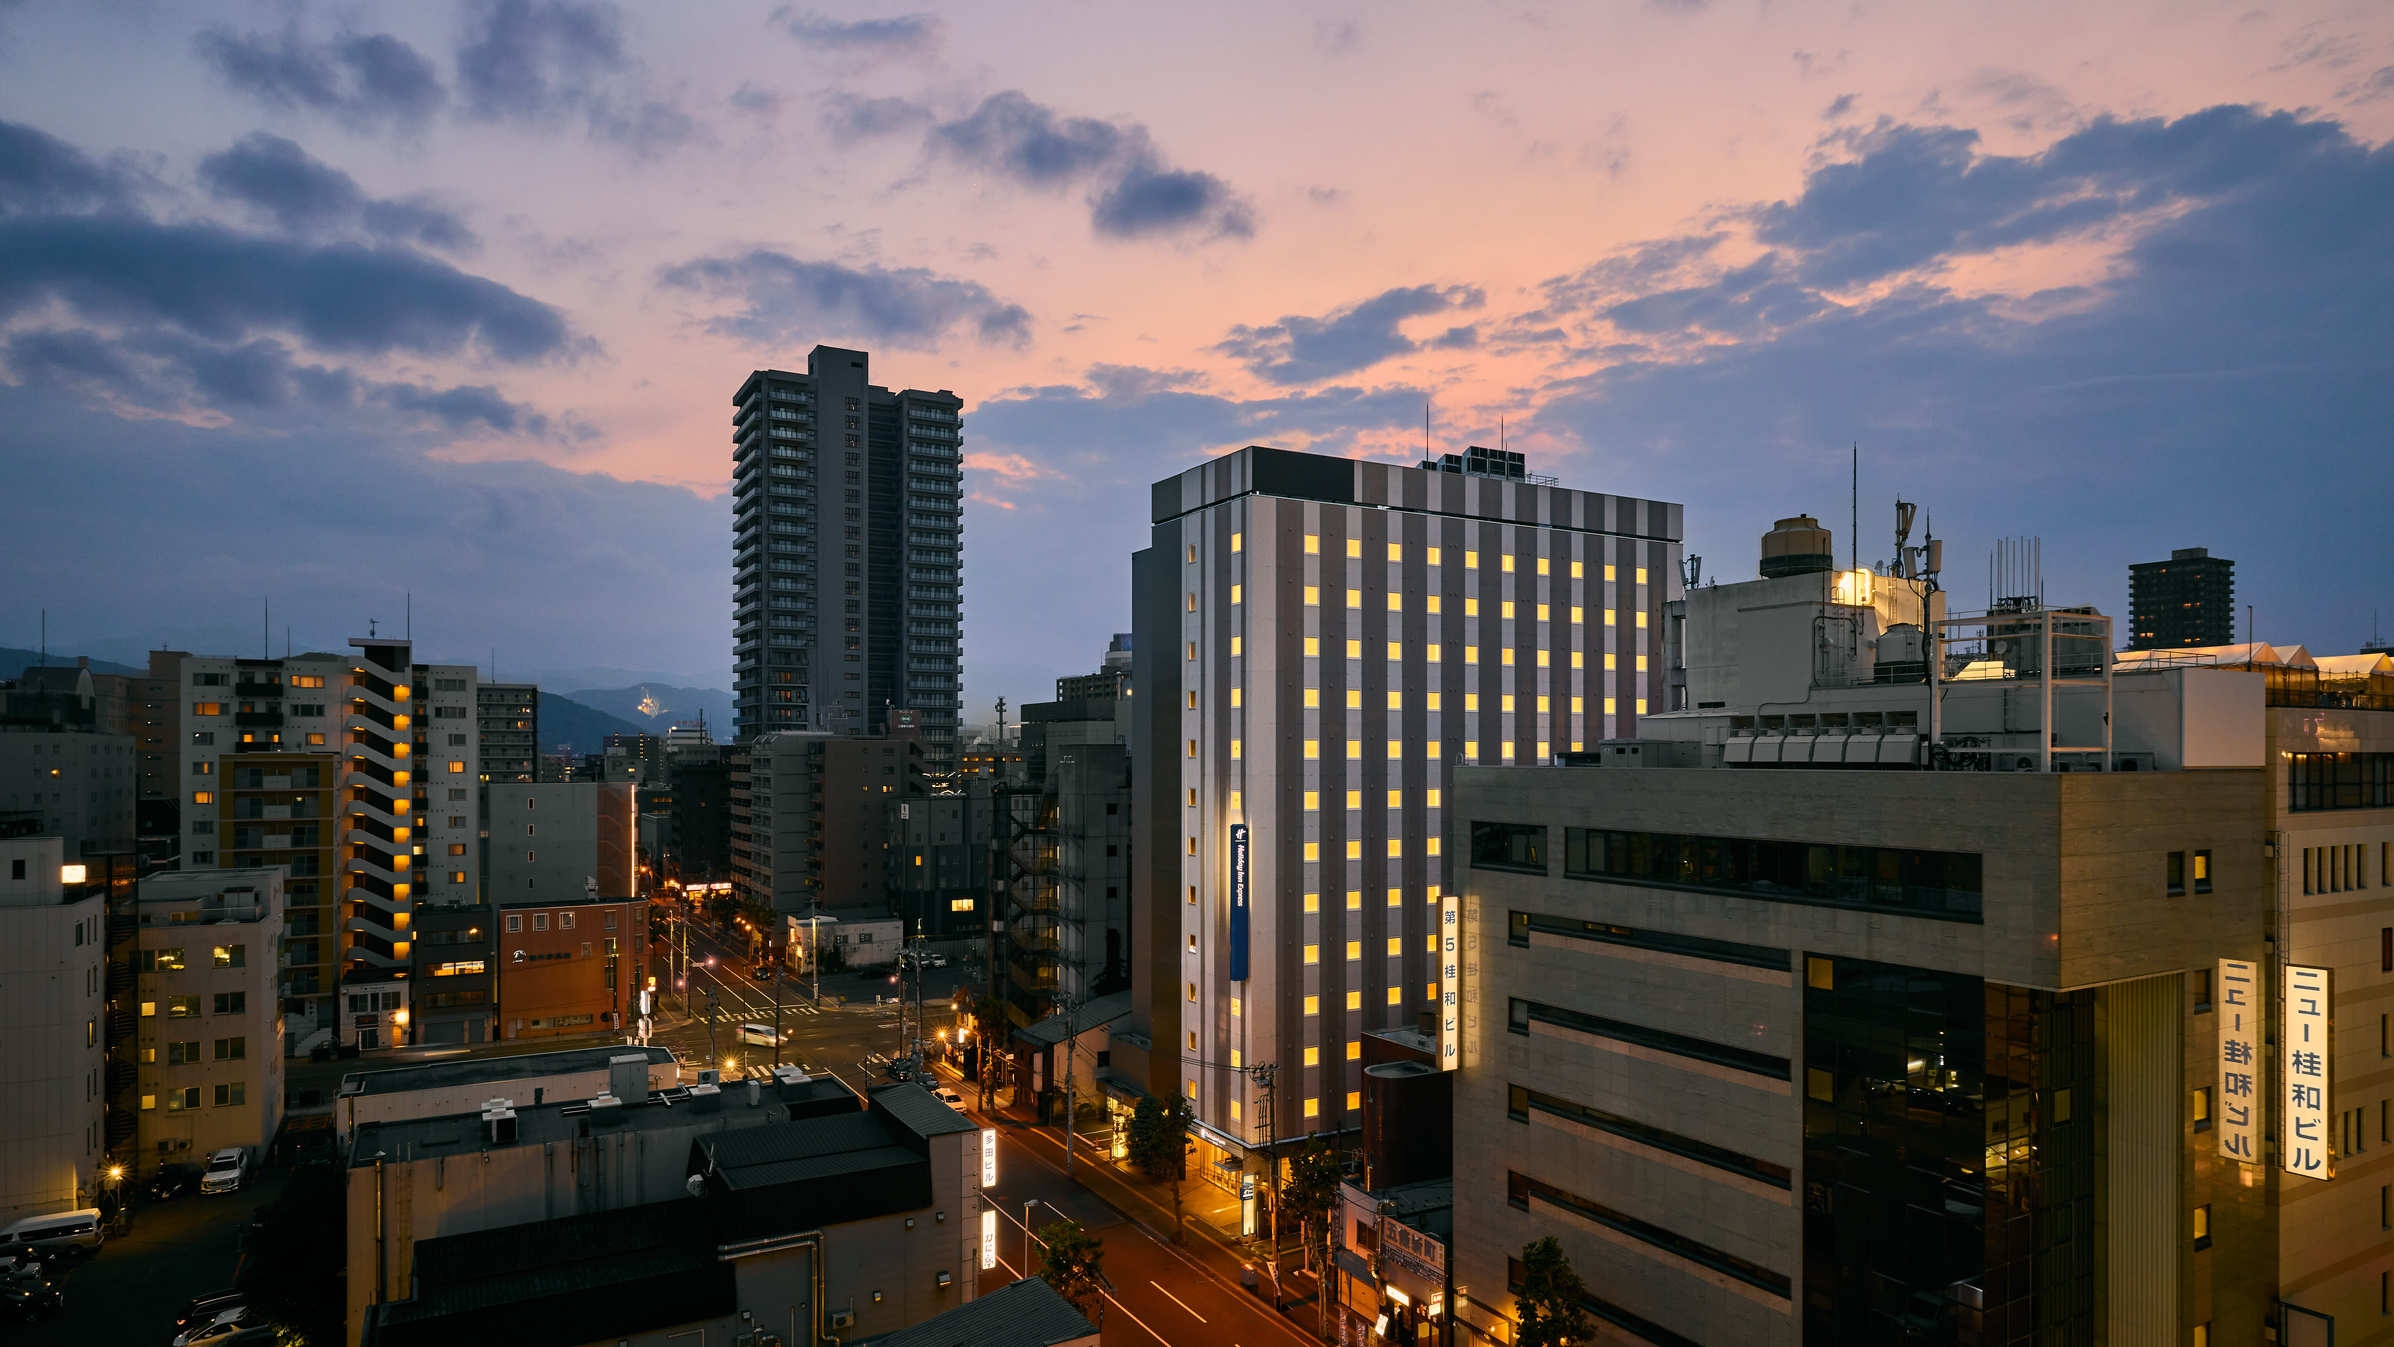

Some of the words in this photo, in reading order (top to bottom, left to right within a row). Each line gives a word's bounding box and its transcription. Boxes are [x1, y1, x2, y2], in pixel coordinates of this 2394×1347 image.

[1236, 845, 1245, 870] Holiday
[1237, 871, 1245, 883] Inn
[1236, 883, 1244, 907] Express
[1444, 910, 1456, 1058] 第5桂和ビル
[2292, 971, 2321, 1171] ニュー桂和ビル
